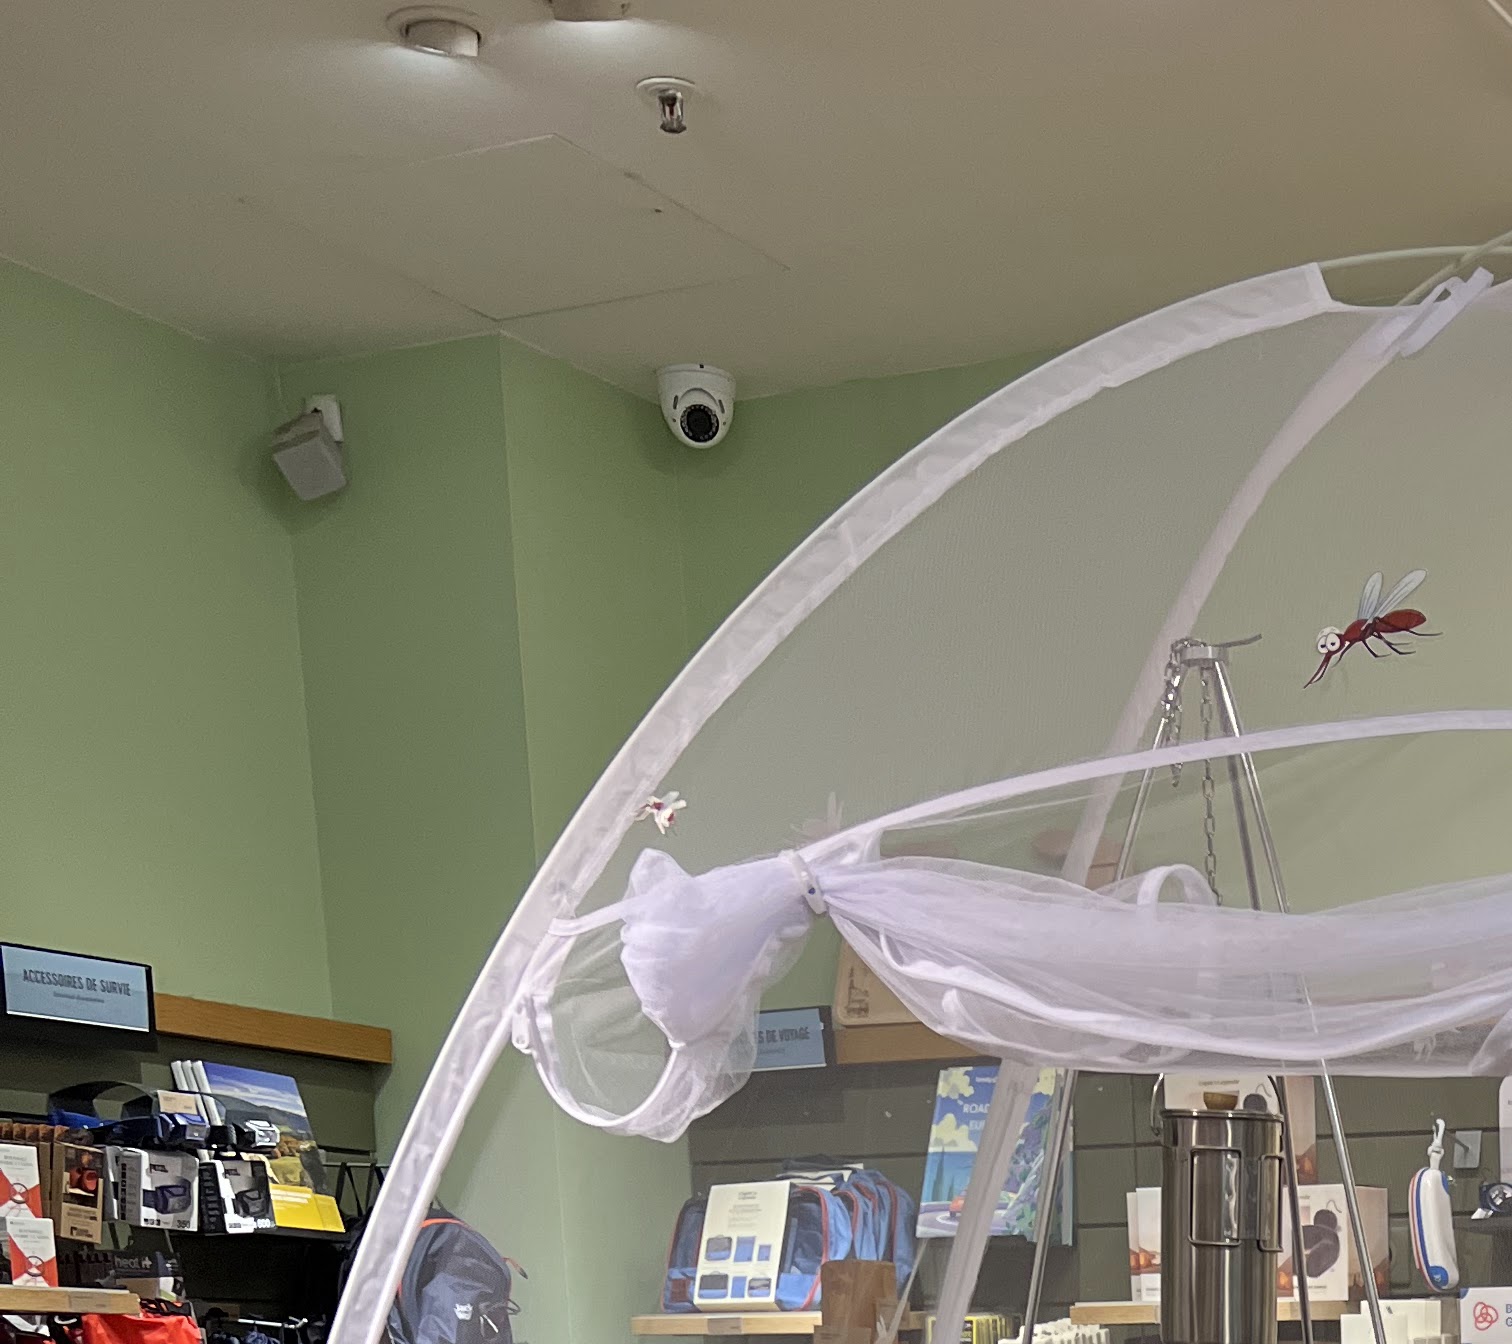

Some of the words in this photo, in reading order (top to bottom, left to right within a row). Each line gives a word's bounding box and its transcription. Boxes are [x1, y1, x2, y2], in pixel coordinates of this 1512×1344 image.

[23, 969, 84, 990] ACCESSOIRES
[87, 978, 97, 992] DE
[100, 979, 131, 996] SURVIE
[767, 1030, 777, 1043] DE
[779, 1026, 810, 1042] VOYAGE
